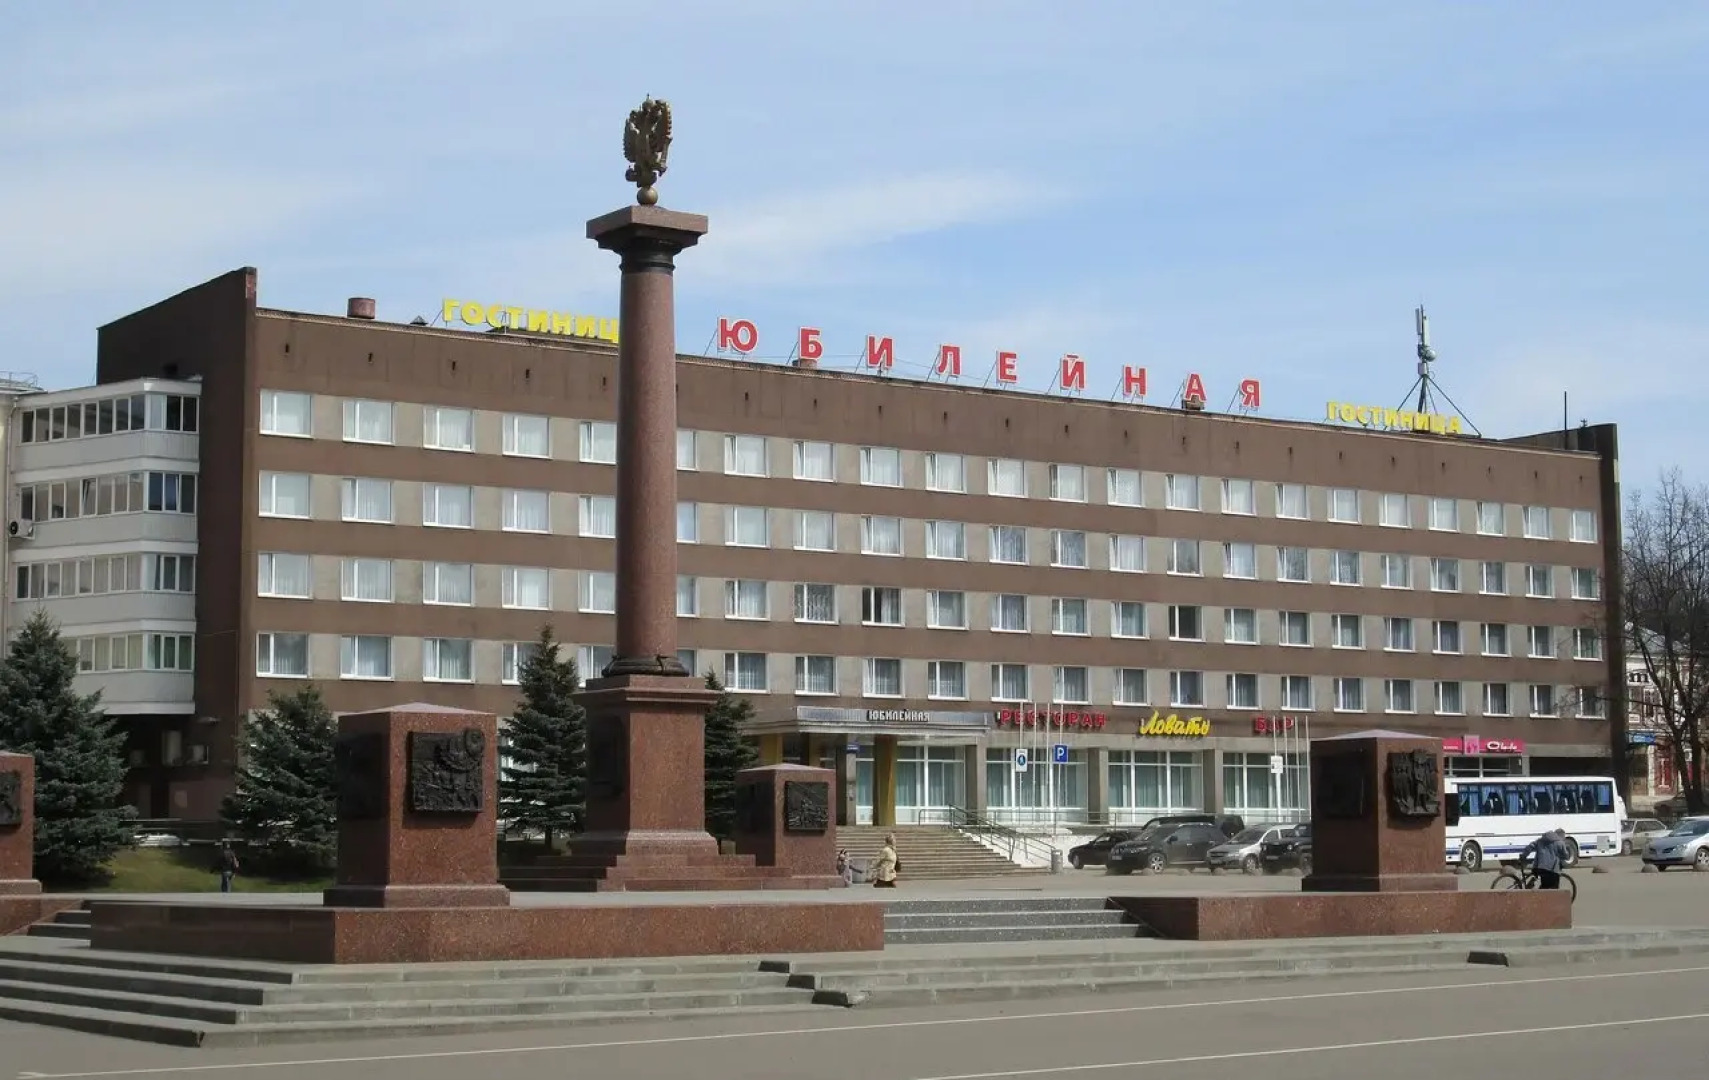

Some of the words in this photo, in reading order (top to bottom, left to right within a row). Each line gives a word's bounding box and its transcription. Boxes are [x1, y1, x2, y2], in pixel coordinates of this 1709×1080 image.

[442, 298, 619, 343] ГОСТИНИЦ
[717, 317, 1260, 408] ЮБИЛЕЙНАЯ
[1327, 400, 1462, 434] ГОСТИНИЦА
[869, 709, 930, 722] ЮБИЛЕЙНАЯ
